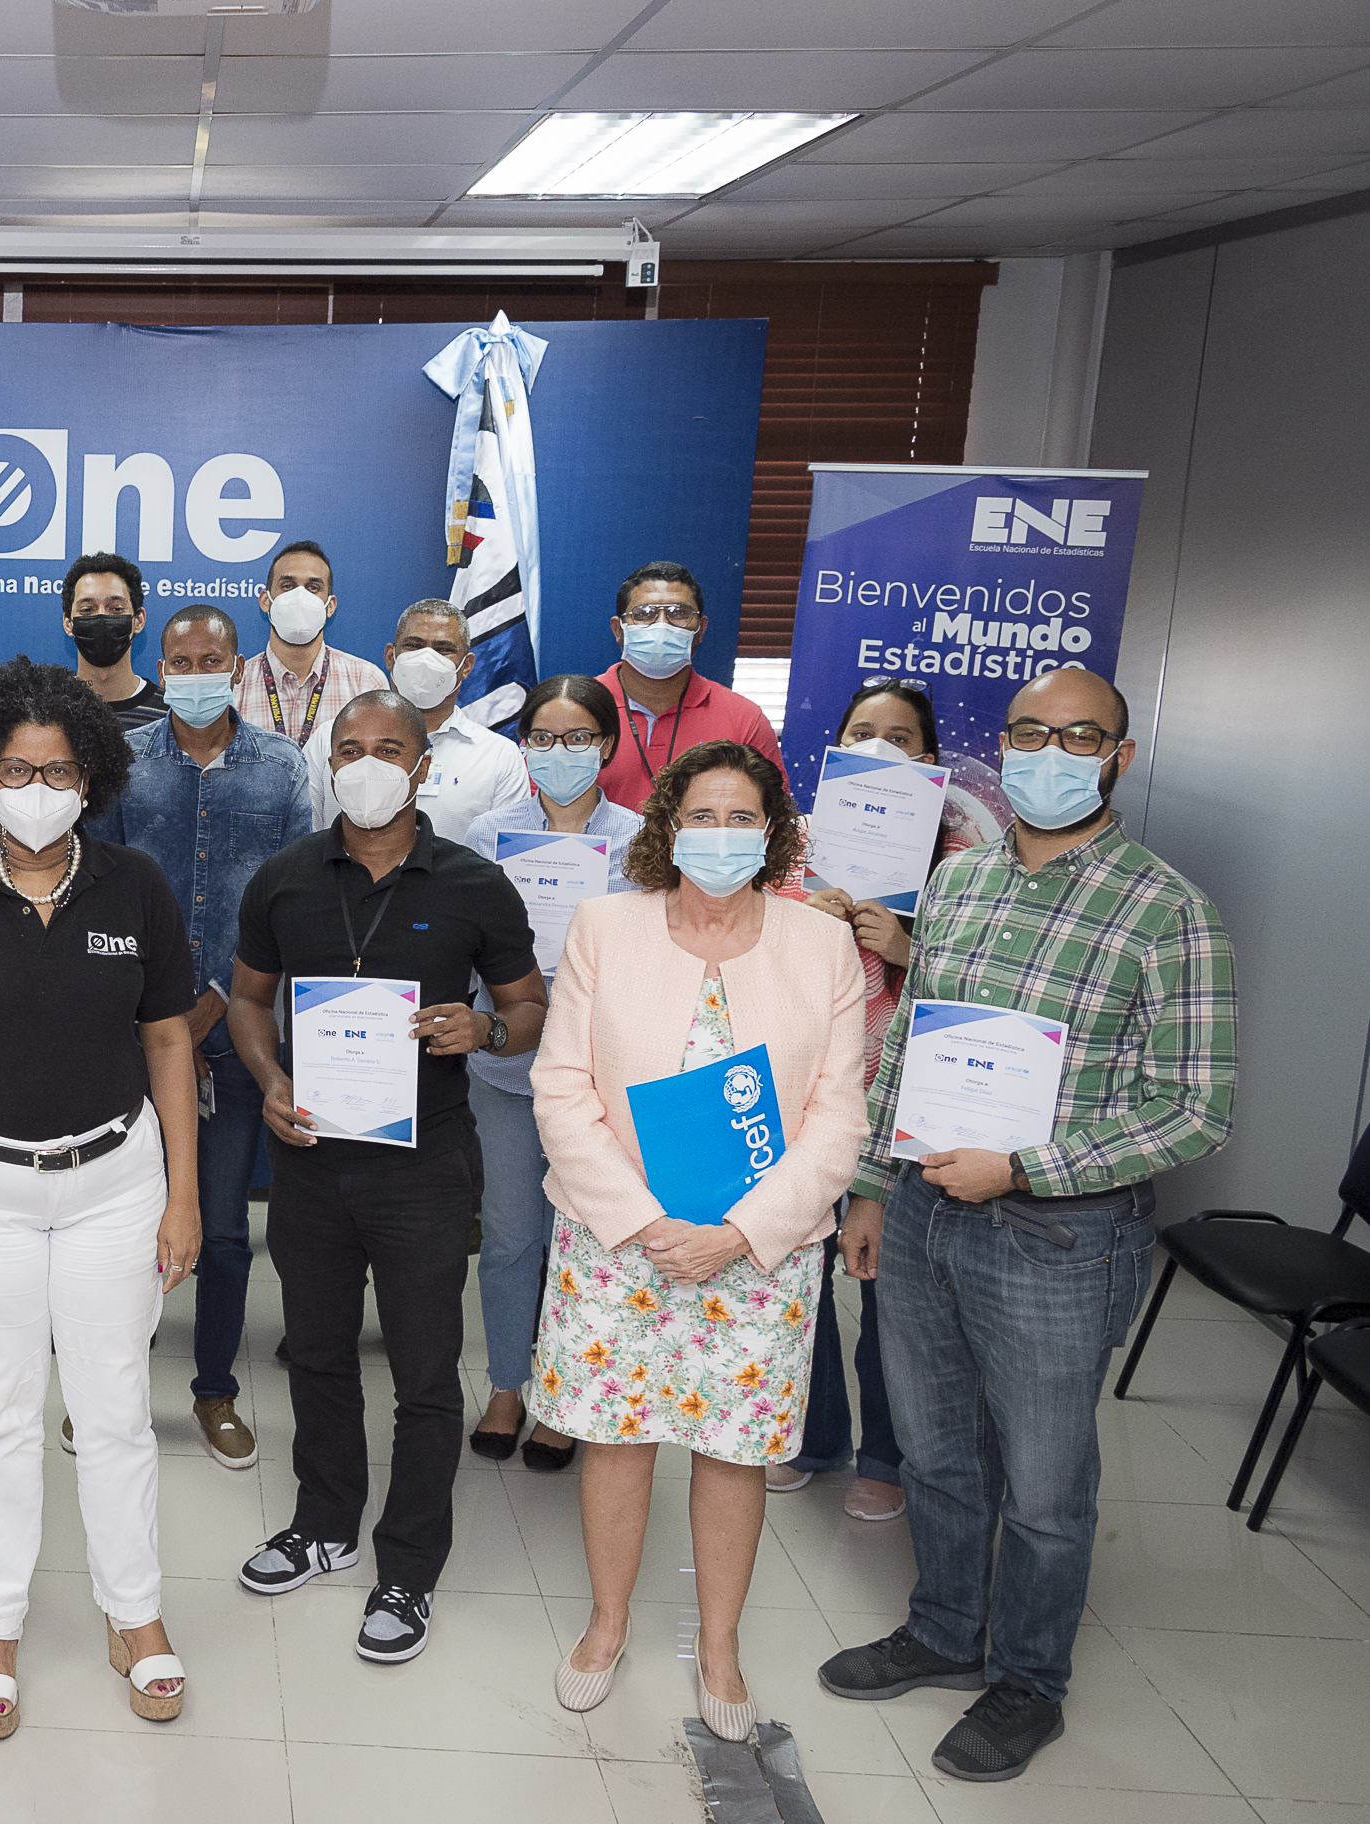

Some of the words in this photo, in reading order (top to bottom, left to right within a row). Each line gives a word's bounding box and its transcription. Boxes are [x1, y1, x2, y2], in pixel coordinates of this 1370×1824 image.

[971, 496, 1111, 547] ENE
[970, 544, 1001, 552] Escuela
[1003, 545, 1038, 554] Nacional
[1040, 546, 1051, 554] de
[1054, 547, 1104, 557] Estadísticas
[157, 577, 267, 598] estadístic
[815, 570, 1091, 619] Bienvenidos
[912, 618, 926, 633] al
[931, 611, 1092, 654] Mundo
[858, 639, 1086, 681] Estadístic
[865, 804, 887, 814] ENE
[539, 878, 558, 886] ENE
[345, 1030, 367, 1039] ENE
[967, 1058, 994, 1070] ENE
[731, 1113, 775, 1185] icef
